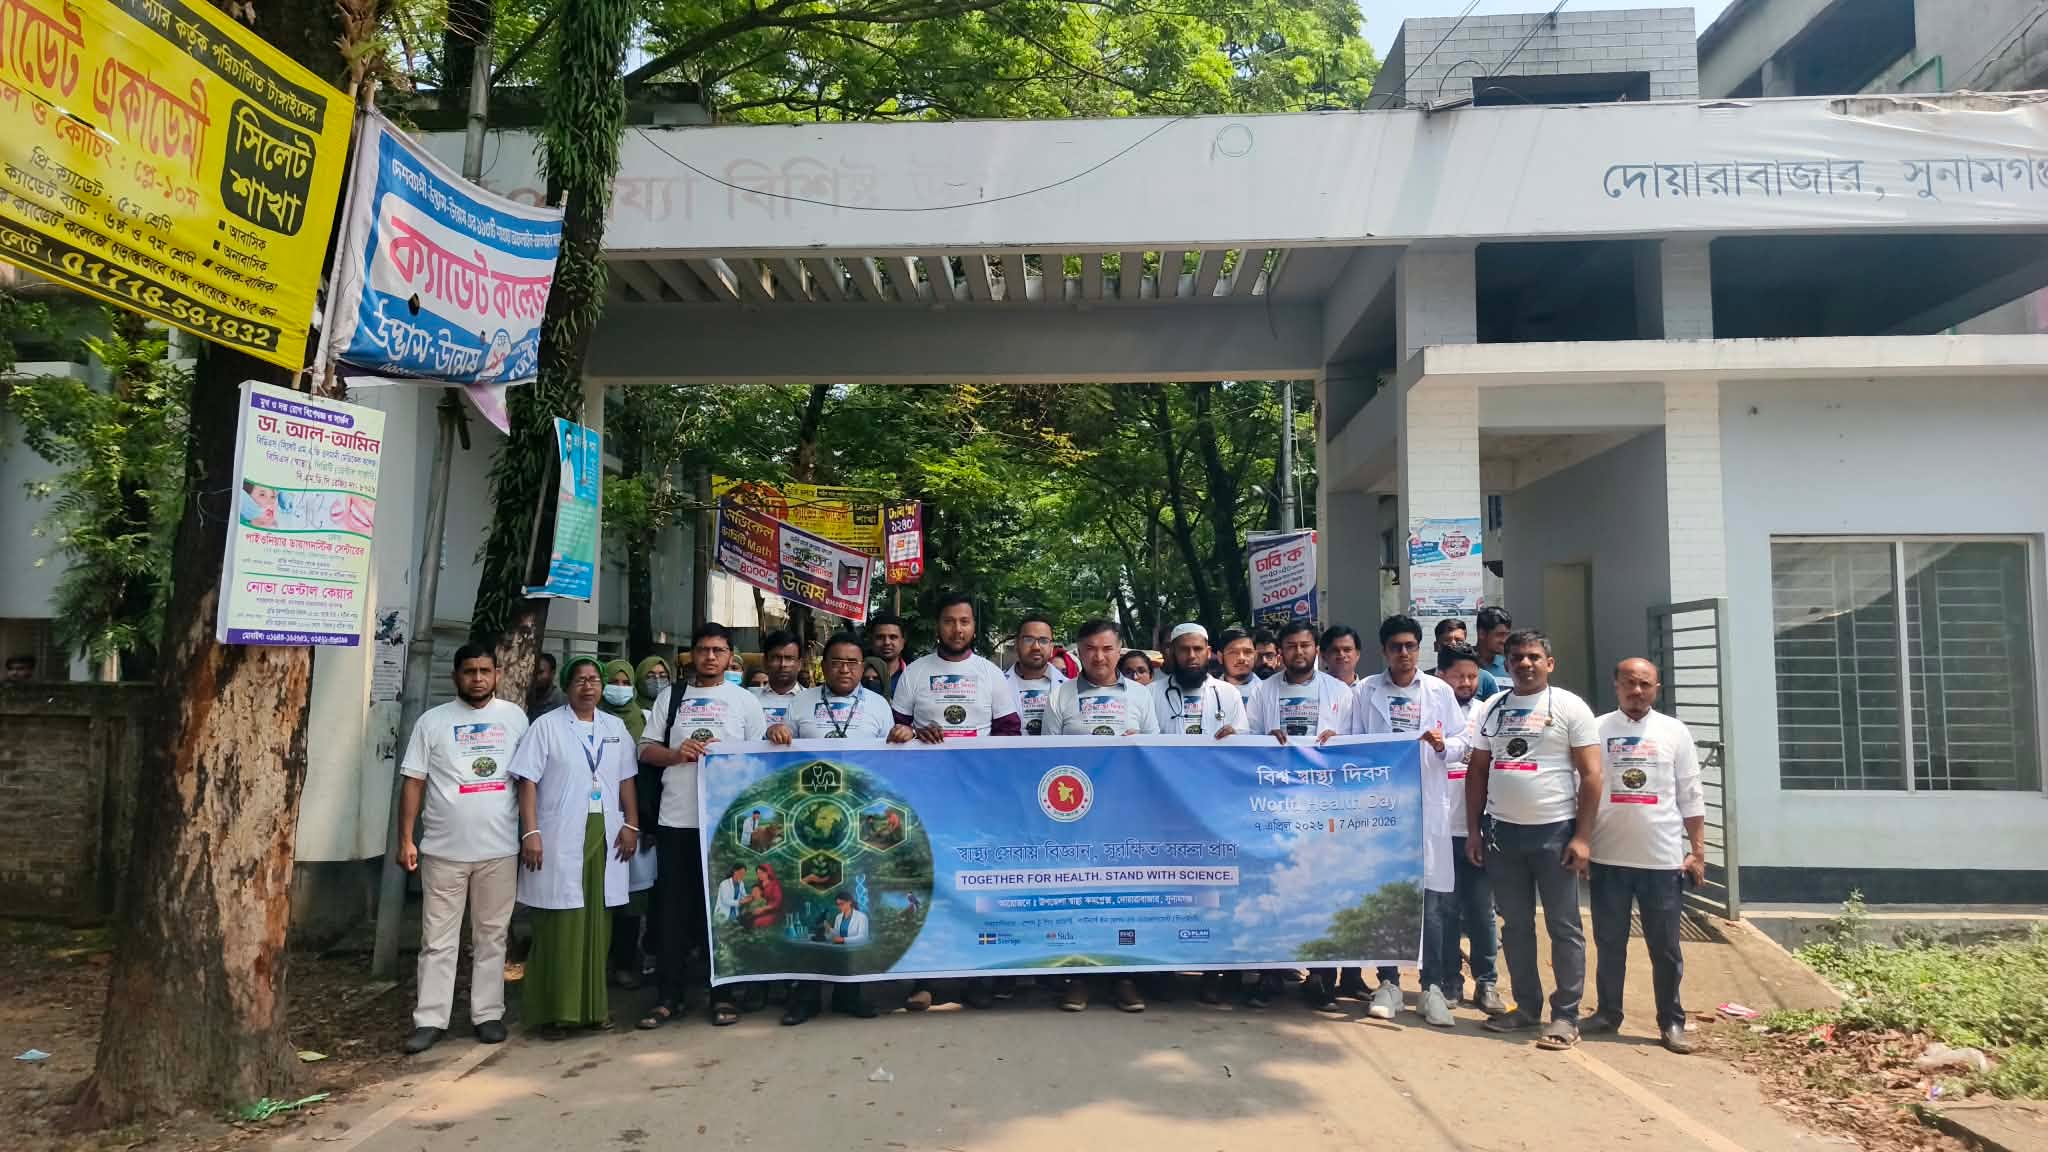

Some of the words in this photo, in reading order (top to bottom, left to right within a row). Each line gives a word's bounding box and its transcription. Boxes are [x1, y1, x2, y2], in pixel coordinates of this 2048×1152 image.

[212, 43, 266, 94] পরিচালিত
[32, 101, 48, 125] ও
[55, 115, 113, 168] কোচিং
[93, 57, 211, 185] একাডেমী
[235, 106, 314, 181] সিলেট
[31, 145, 104, 197] প্রি-ক্যাডেট
[5, 162, 58, 199] ক্যাডেট
[60, 192, 91, 216] ব্যাচ
[230, 168, 303, 233] শাখা
[11, 193, 65, 227] ক্যাডেট
[229, 225, 267, 252] আবাসিক
[223, 245, 269, 273] অনাবাসিক
[390, 215, 490, 316] ক্যাডেট
[214, 263, 278, 293] বালক-বালিকা
[258, 415, 281, 434] ডা.
[286, 421, 380, 454] আল-আমিন
[747, 539, 773, 559] Math
[246, 581, 276, 594] নোভা
[282, 582, 318, 597] ডেন্টাল
[323, 587, 353, 600] কেয়ার
[782, 568, 827, 601] উন্মেষ
[1256, 765, 1291, 785] বিশ্ব
[1294, 767, 1336, 789] স্বাস্থ্য
[1341, 763, 1392, 784] দিবস
[1249, 795, 1305, 813] World
[1367, 792, 1396, 811] Day
[1339, 819, 1346, 830] 7
[1348, 817, 1369, 830] April
[1371, 816, 1397, 828] 2026
[1166, 841, 1203, 860] সকল
[1209, 838, 1239, 859] প্রাণ
[961, 874, 1024, 886] TOGETHER
[1027, 873, 1052, 884] FOR
[1105, 871, 1144, 882] STAND
[1146, 870, 1176, 881] WITH
[1179, 869, 1234, 881] SCIENCE.
